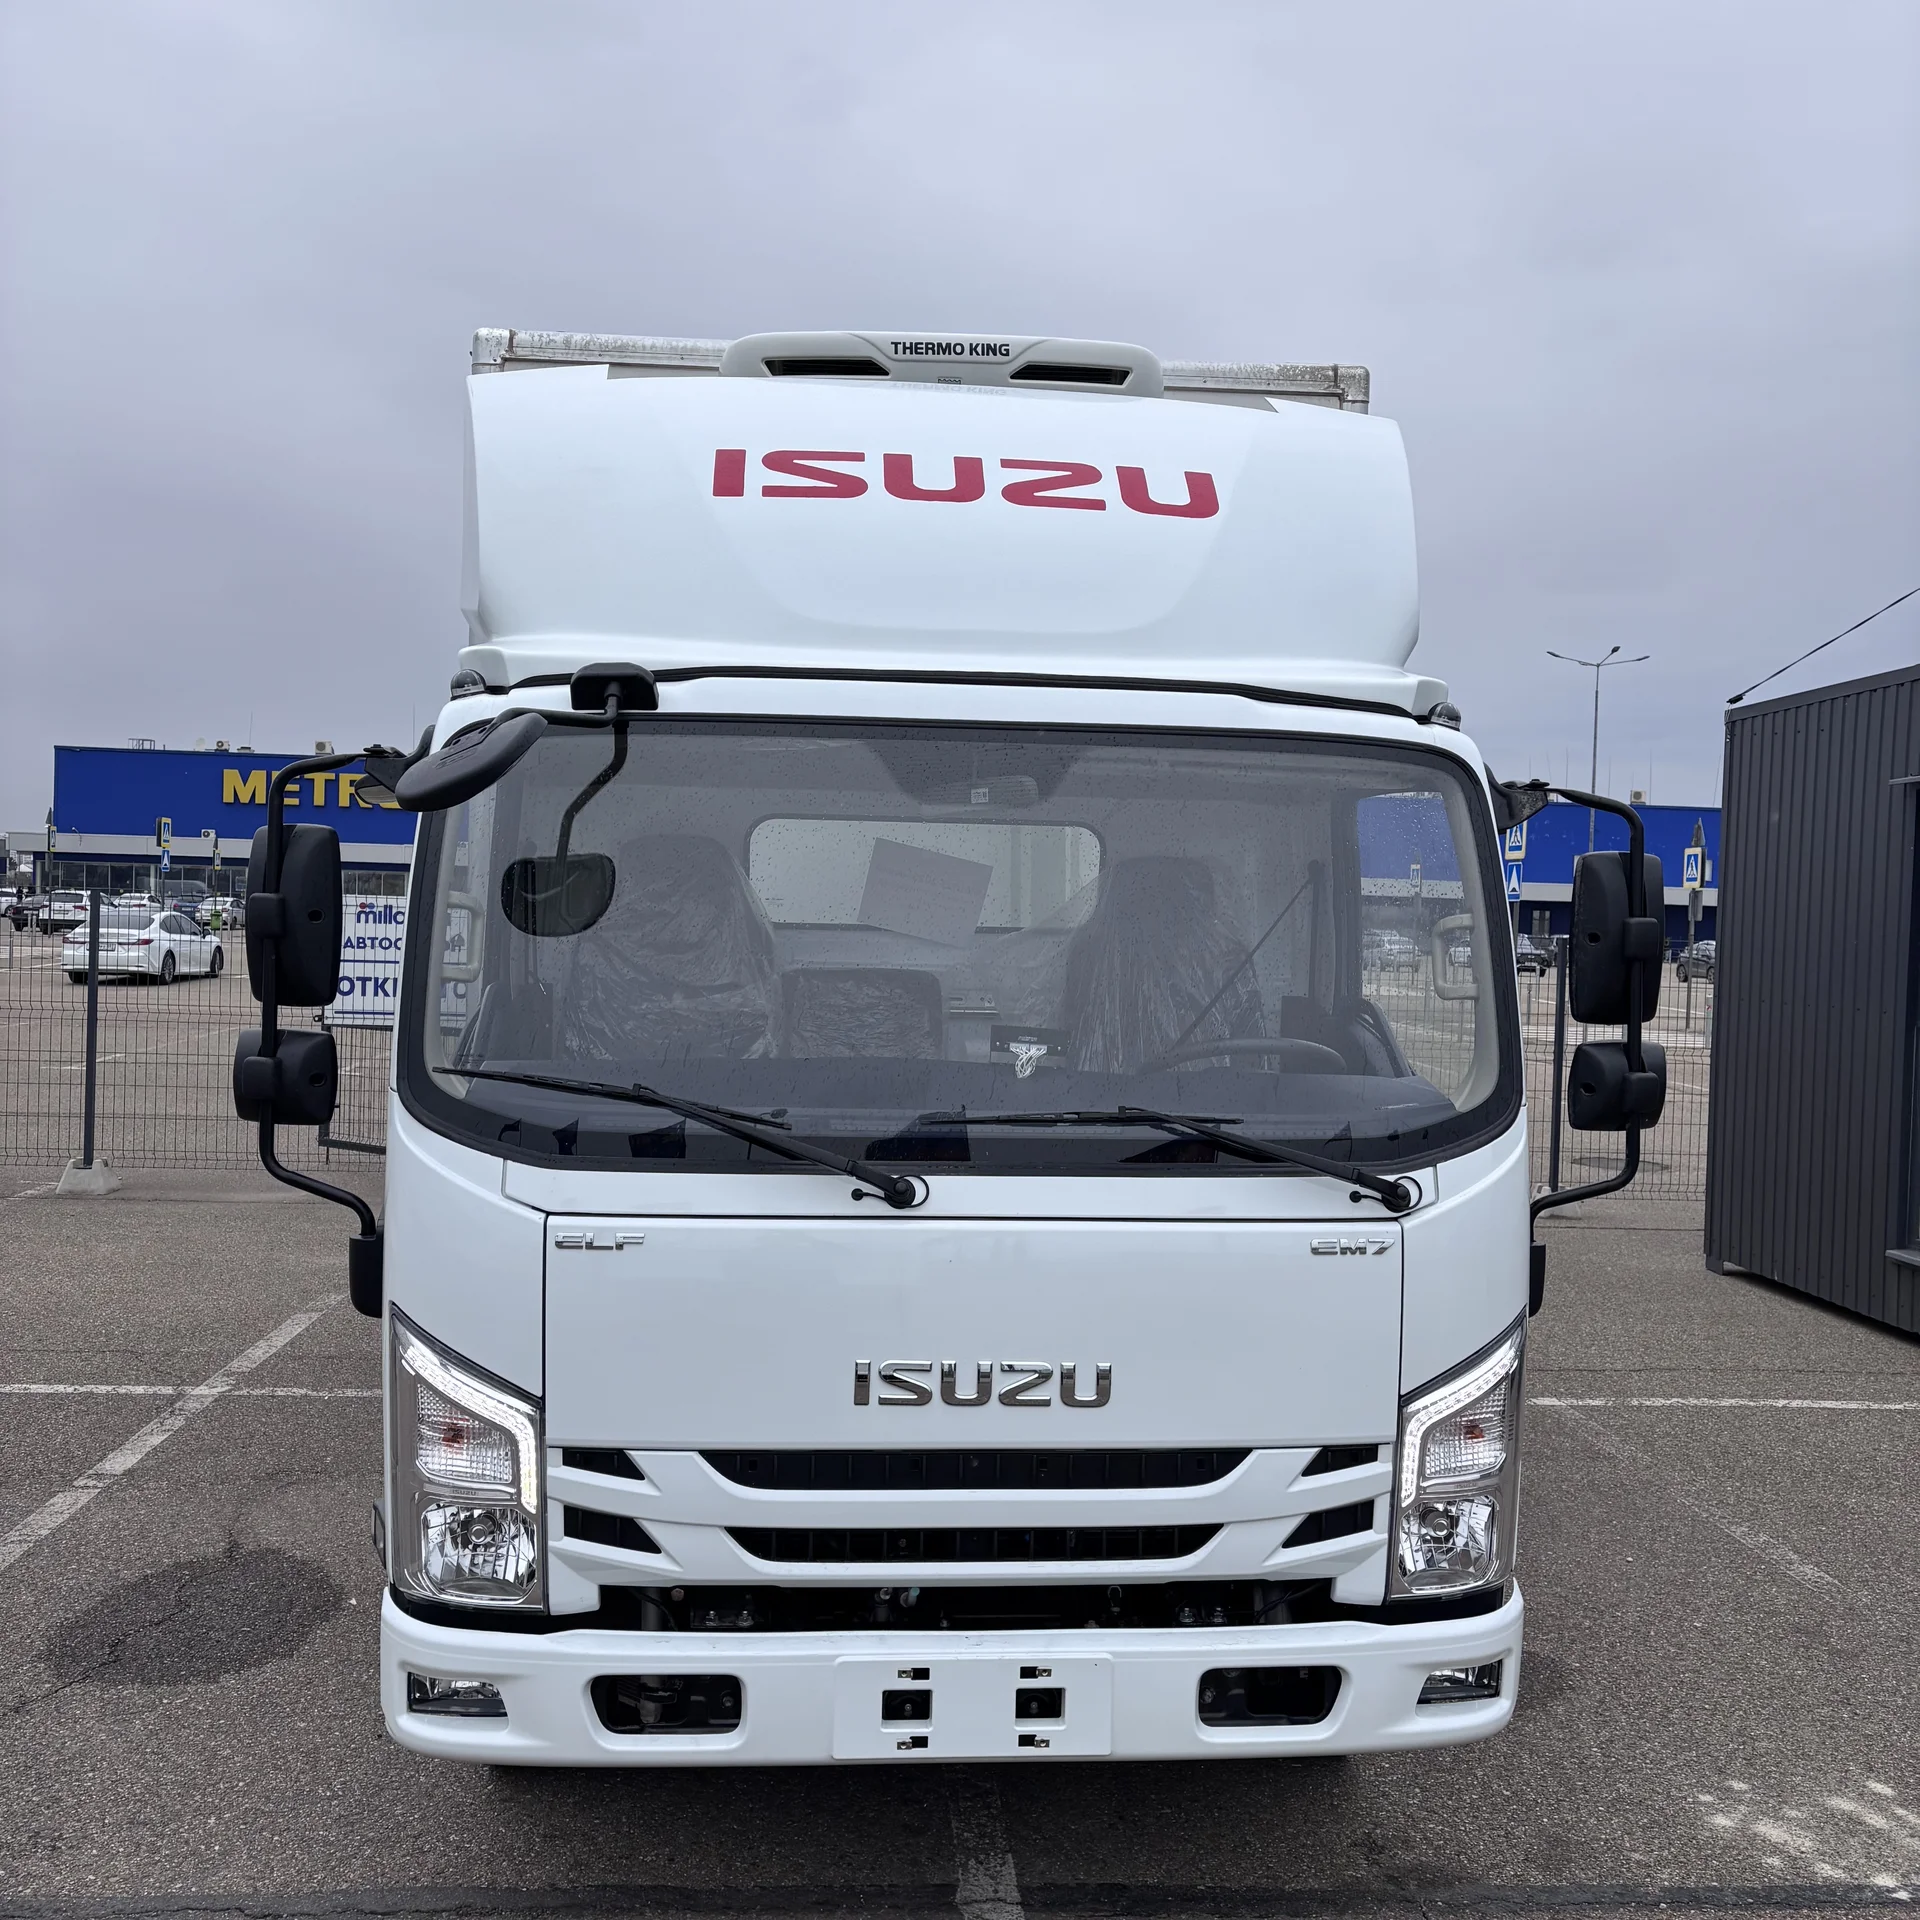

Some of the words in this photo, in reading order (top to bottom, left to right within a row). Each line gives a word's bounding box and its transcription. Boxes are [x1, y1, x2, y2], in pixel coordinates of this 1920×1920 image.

[890, 341, 965, 356] THERMO
[969, 342, 1010, 357] KING
[712, 448, 1220, 519] ISUZU
[222, 768, 403, 810] METR
[555, 1232, 645, 1250] ELF
[1310, 1238, 1395, 1255] EM7
[854, 1359, 1112, 1408] ISUZU
